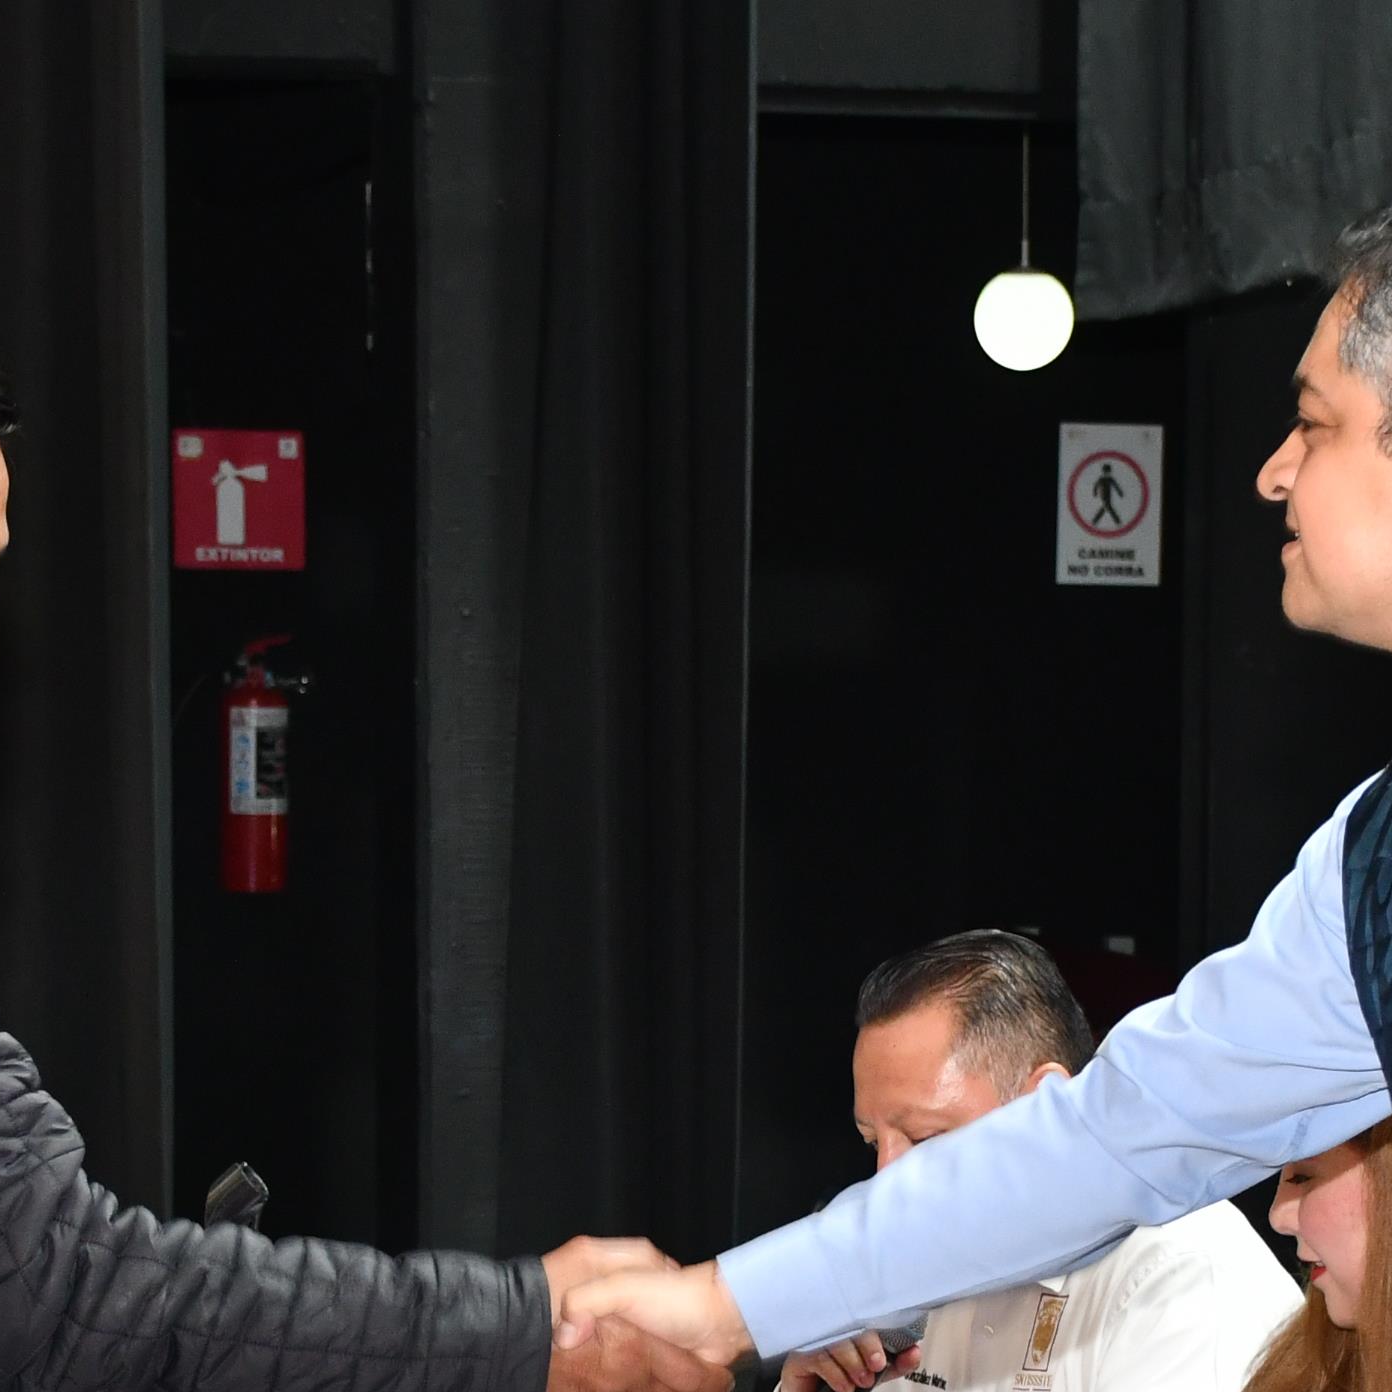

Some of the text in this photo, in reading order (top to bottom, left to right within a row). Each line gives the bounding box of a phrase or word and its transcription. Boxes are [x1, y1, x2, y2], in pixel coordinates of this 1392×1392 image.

[195, 547, 285, 562] EXTINTOR
[1067, 565, 1145, 577] NO CORRA
